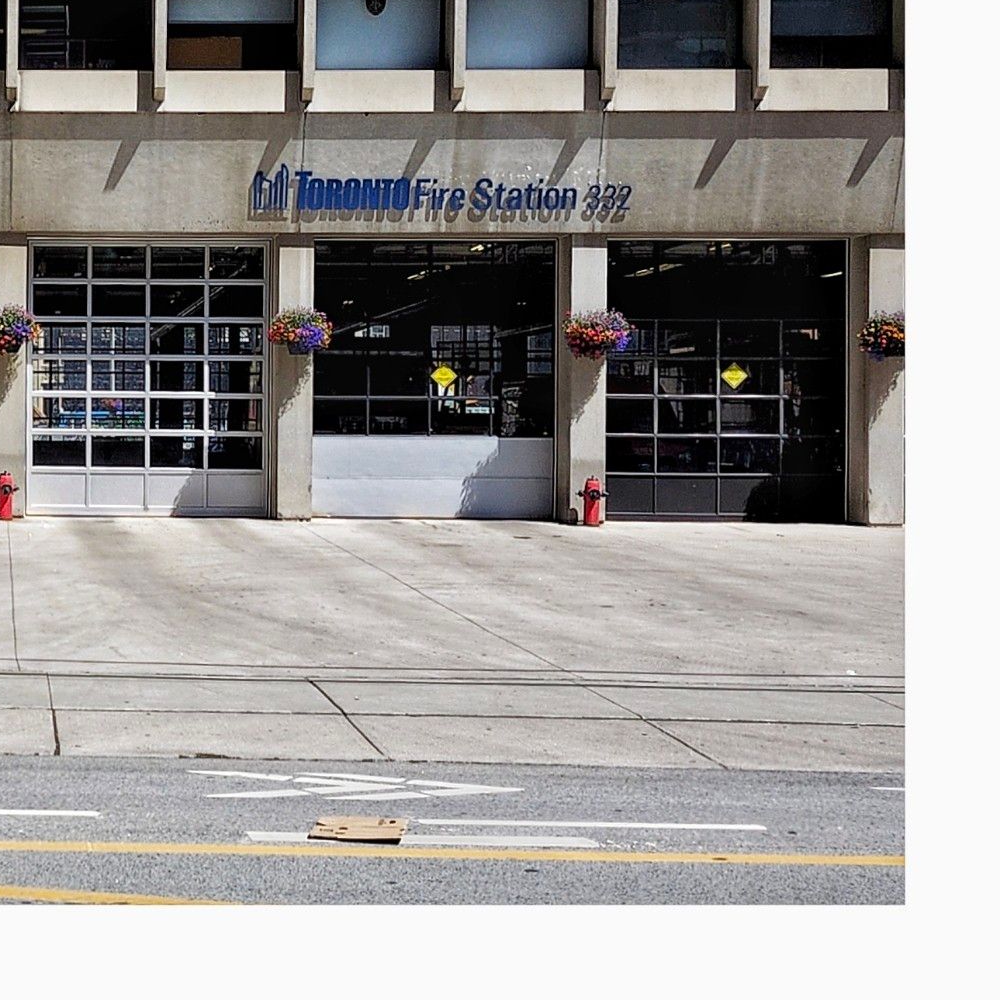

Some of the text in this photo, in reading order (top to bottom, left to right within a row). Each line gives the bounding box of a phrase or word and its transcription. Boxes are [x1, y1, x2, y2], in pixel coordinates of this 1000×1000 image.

[295, 171, 632, 212] TORONTO Fire Station 332
